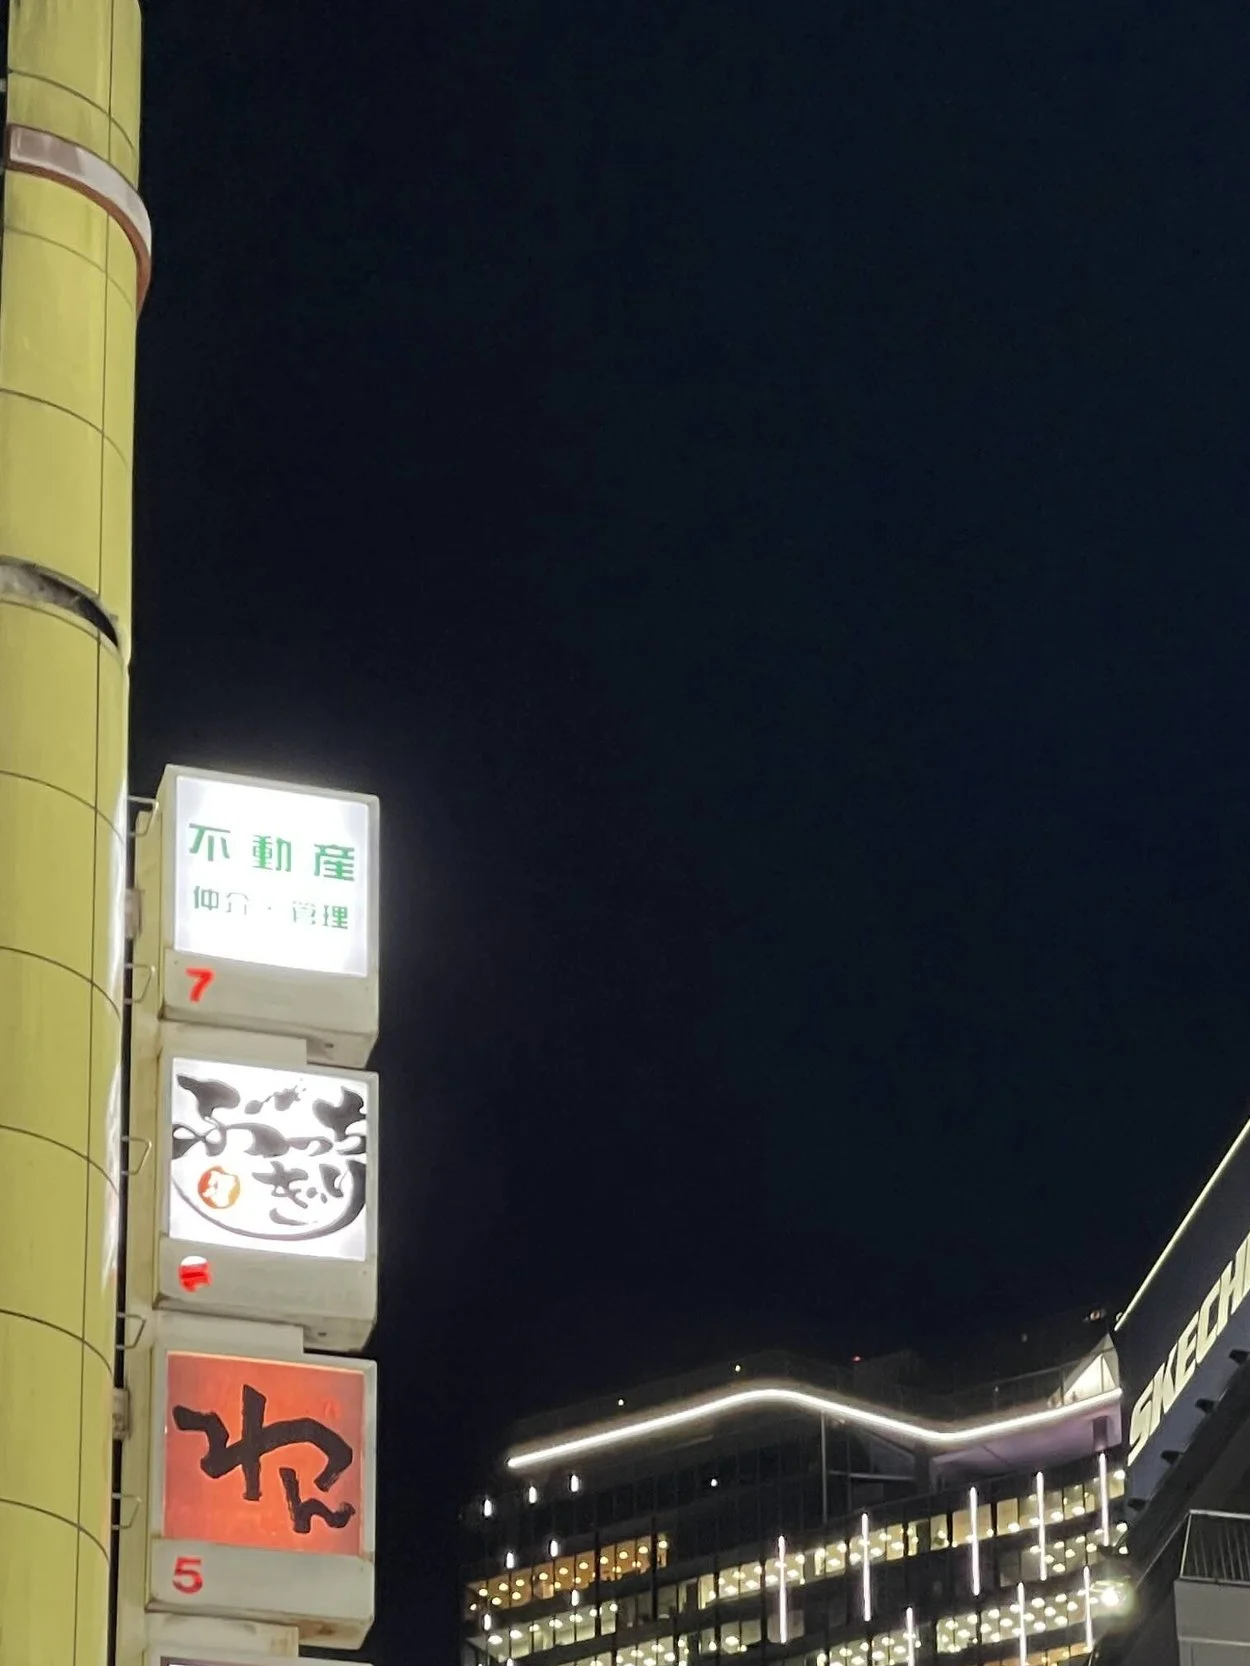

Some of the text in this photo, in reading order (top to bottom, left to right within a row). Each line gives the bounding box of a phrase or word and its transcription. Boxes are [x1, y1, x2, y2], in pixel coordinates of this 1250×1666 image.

[189, 823, 355, 881] 不動産
[186, 968, 214, 1003] 7
[172, 1557, 203, 1593] 5
